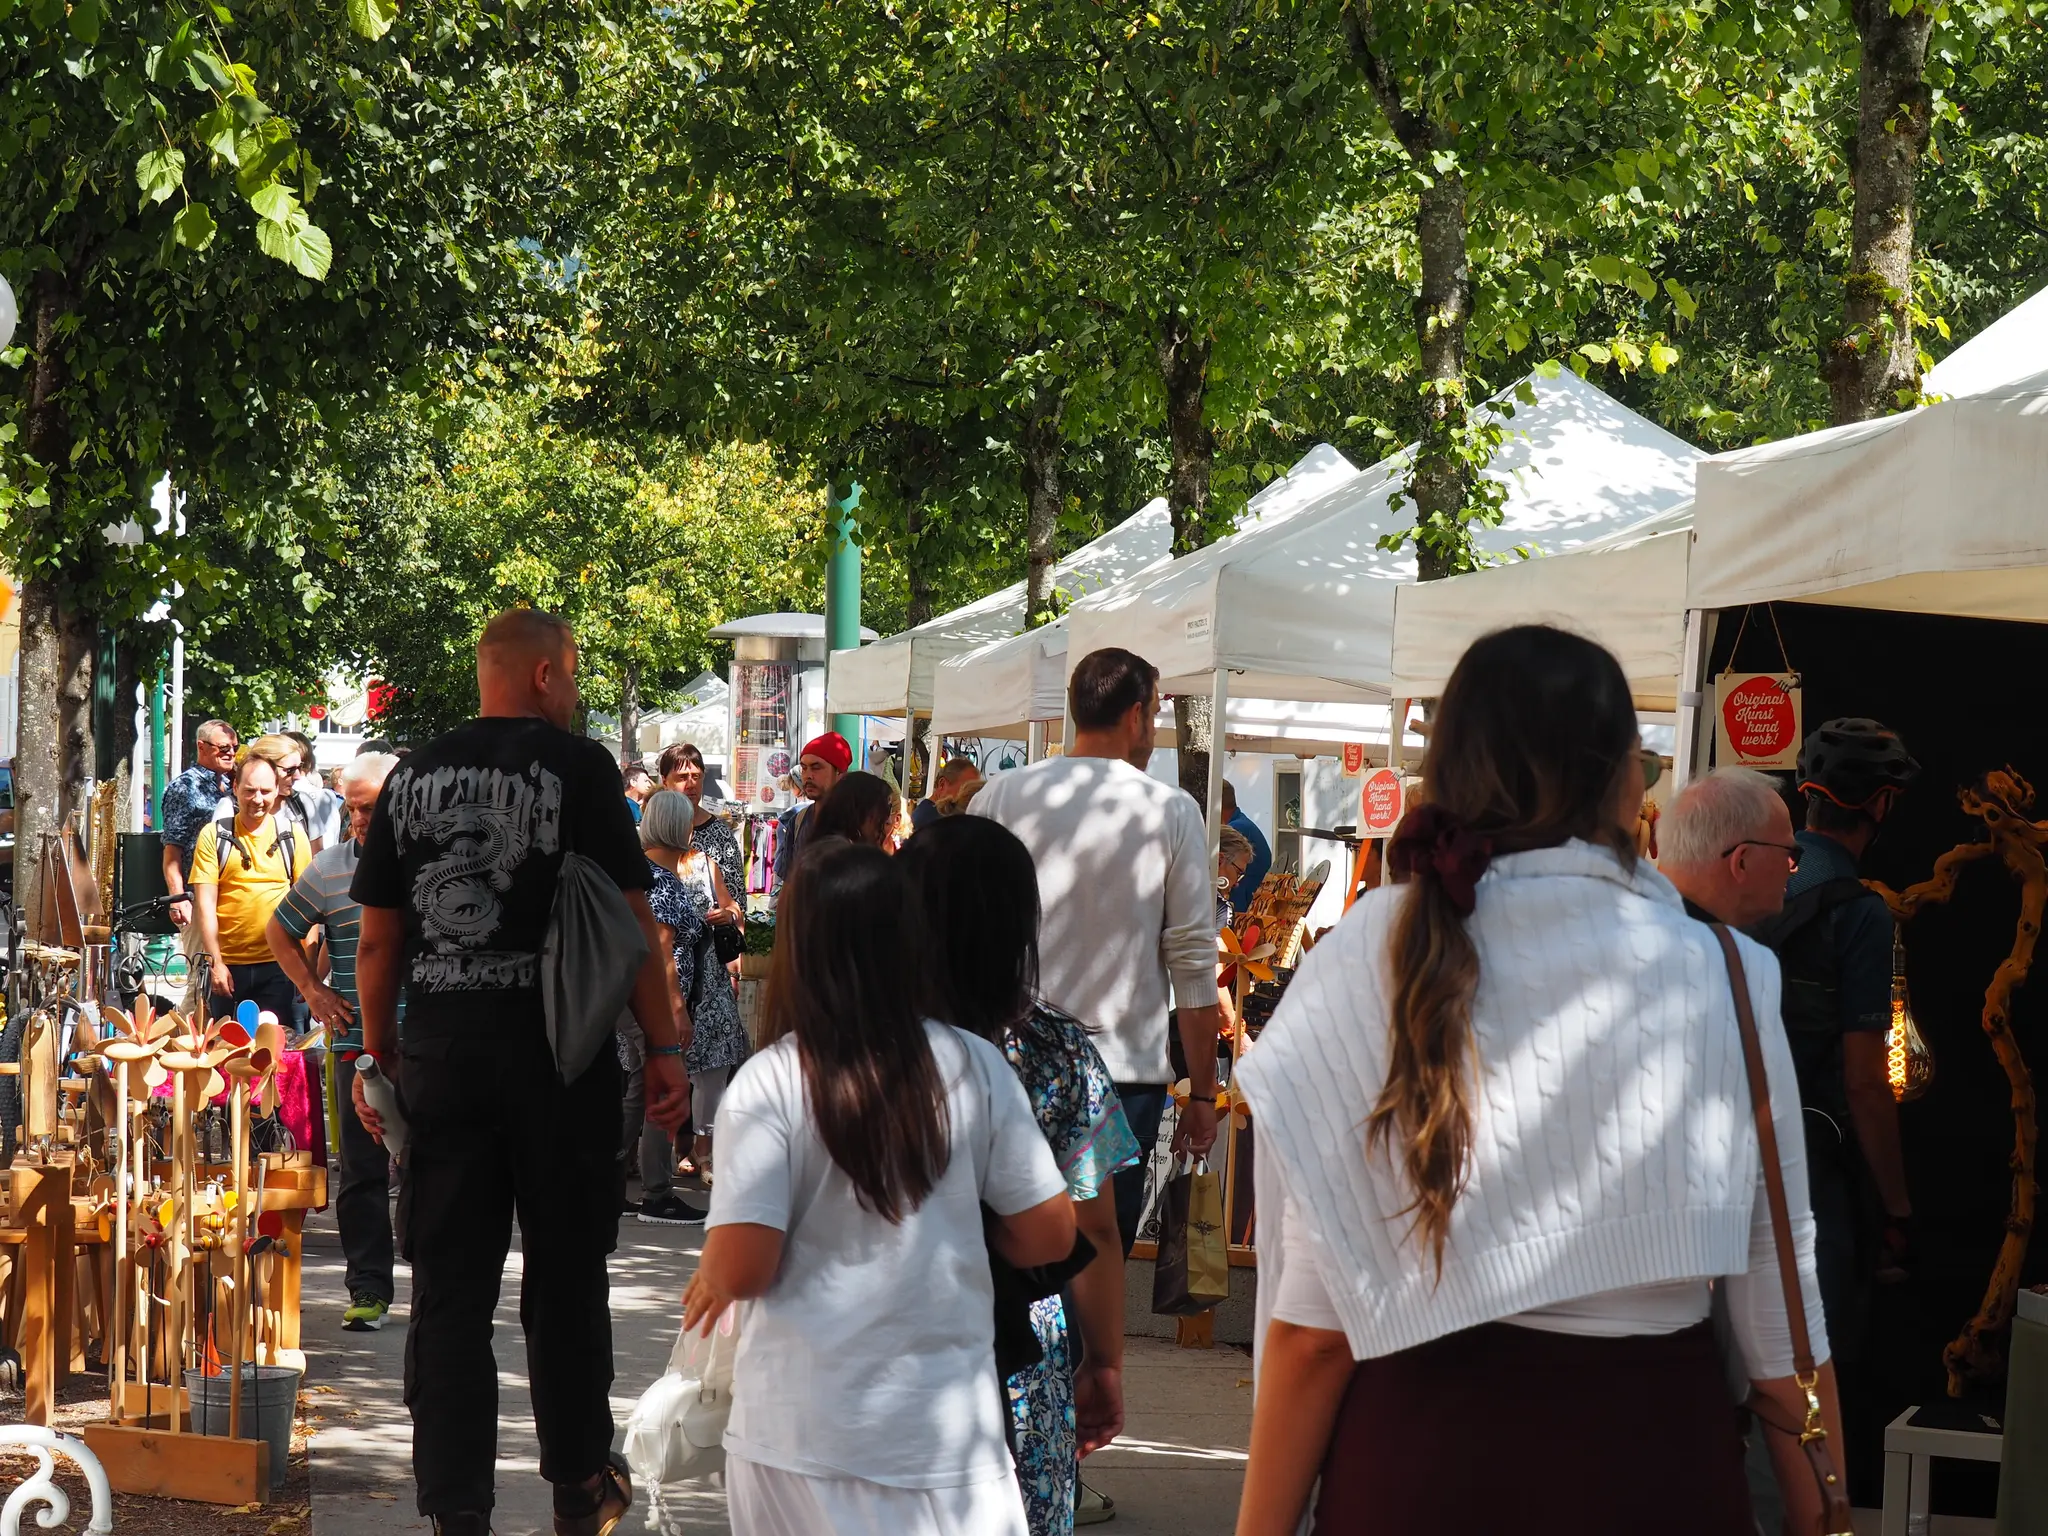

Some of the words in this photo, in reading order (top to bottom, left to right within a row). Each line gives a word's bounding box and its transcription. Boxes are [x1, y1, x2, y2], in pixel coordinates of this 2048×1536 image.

[1734, 692, 1785, 708] Original
[1735, 707, 1775, 723] Kunst
[1747, 721, 1779, 733] hand
[1741, 733, 1779, 745] werk!
[1368, 781, 1397, 794] Original
